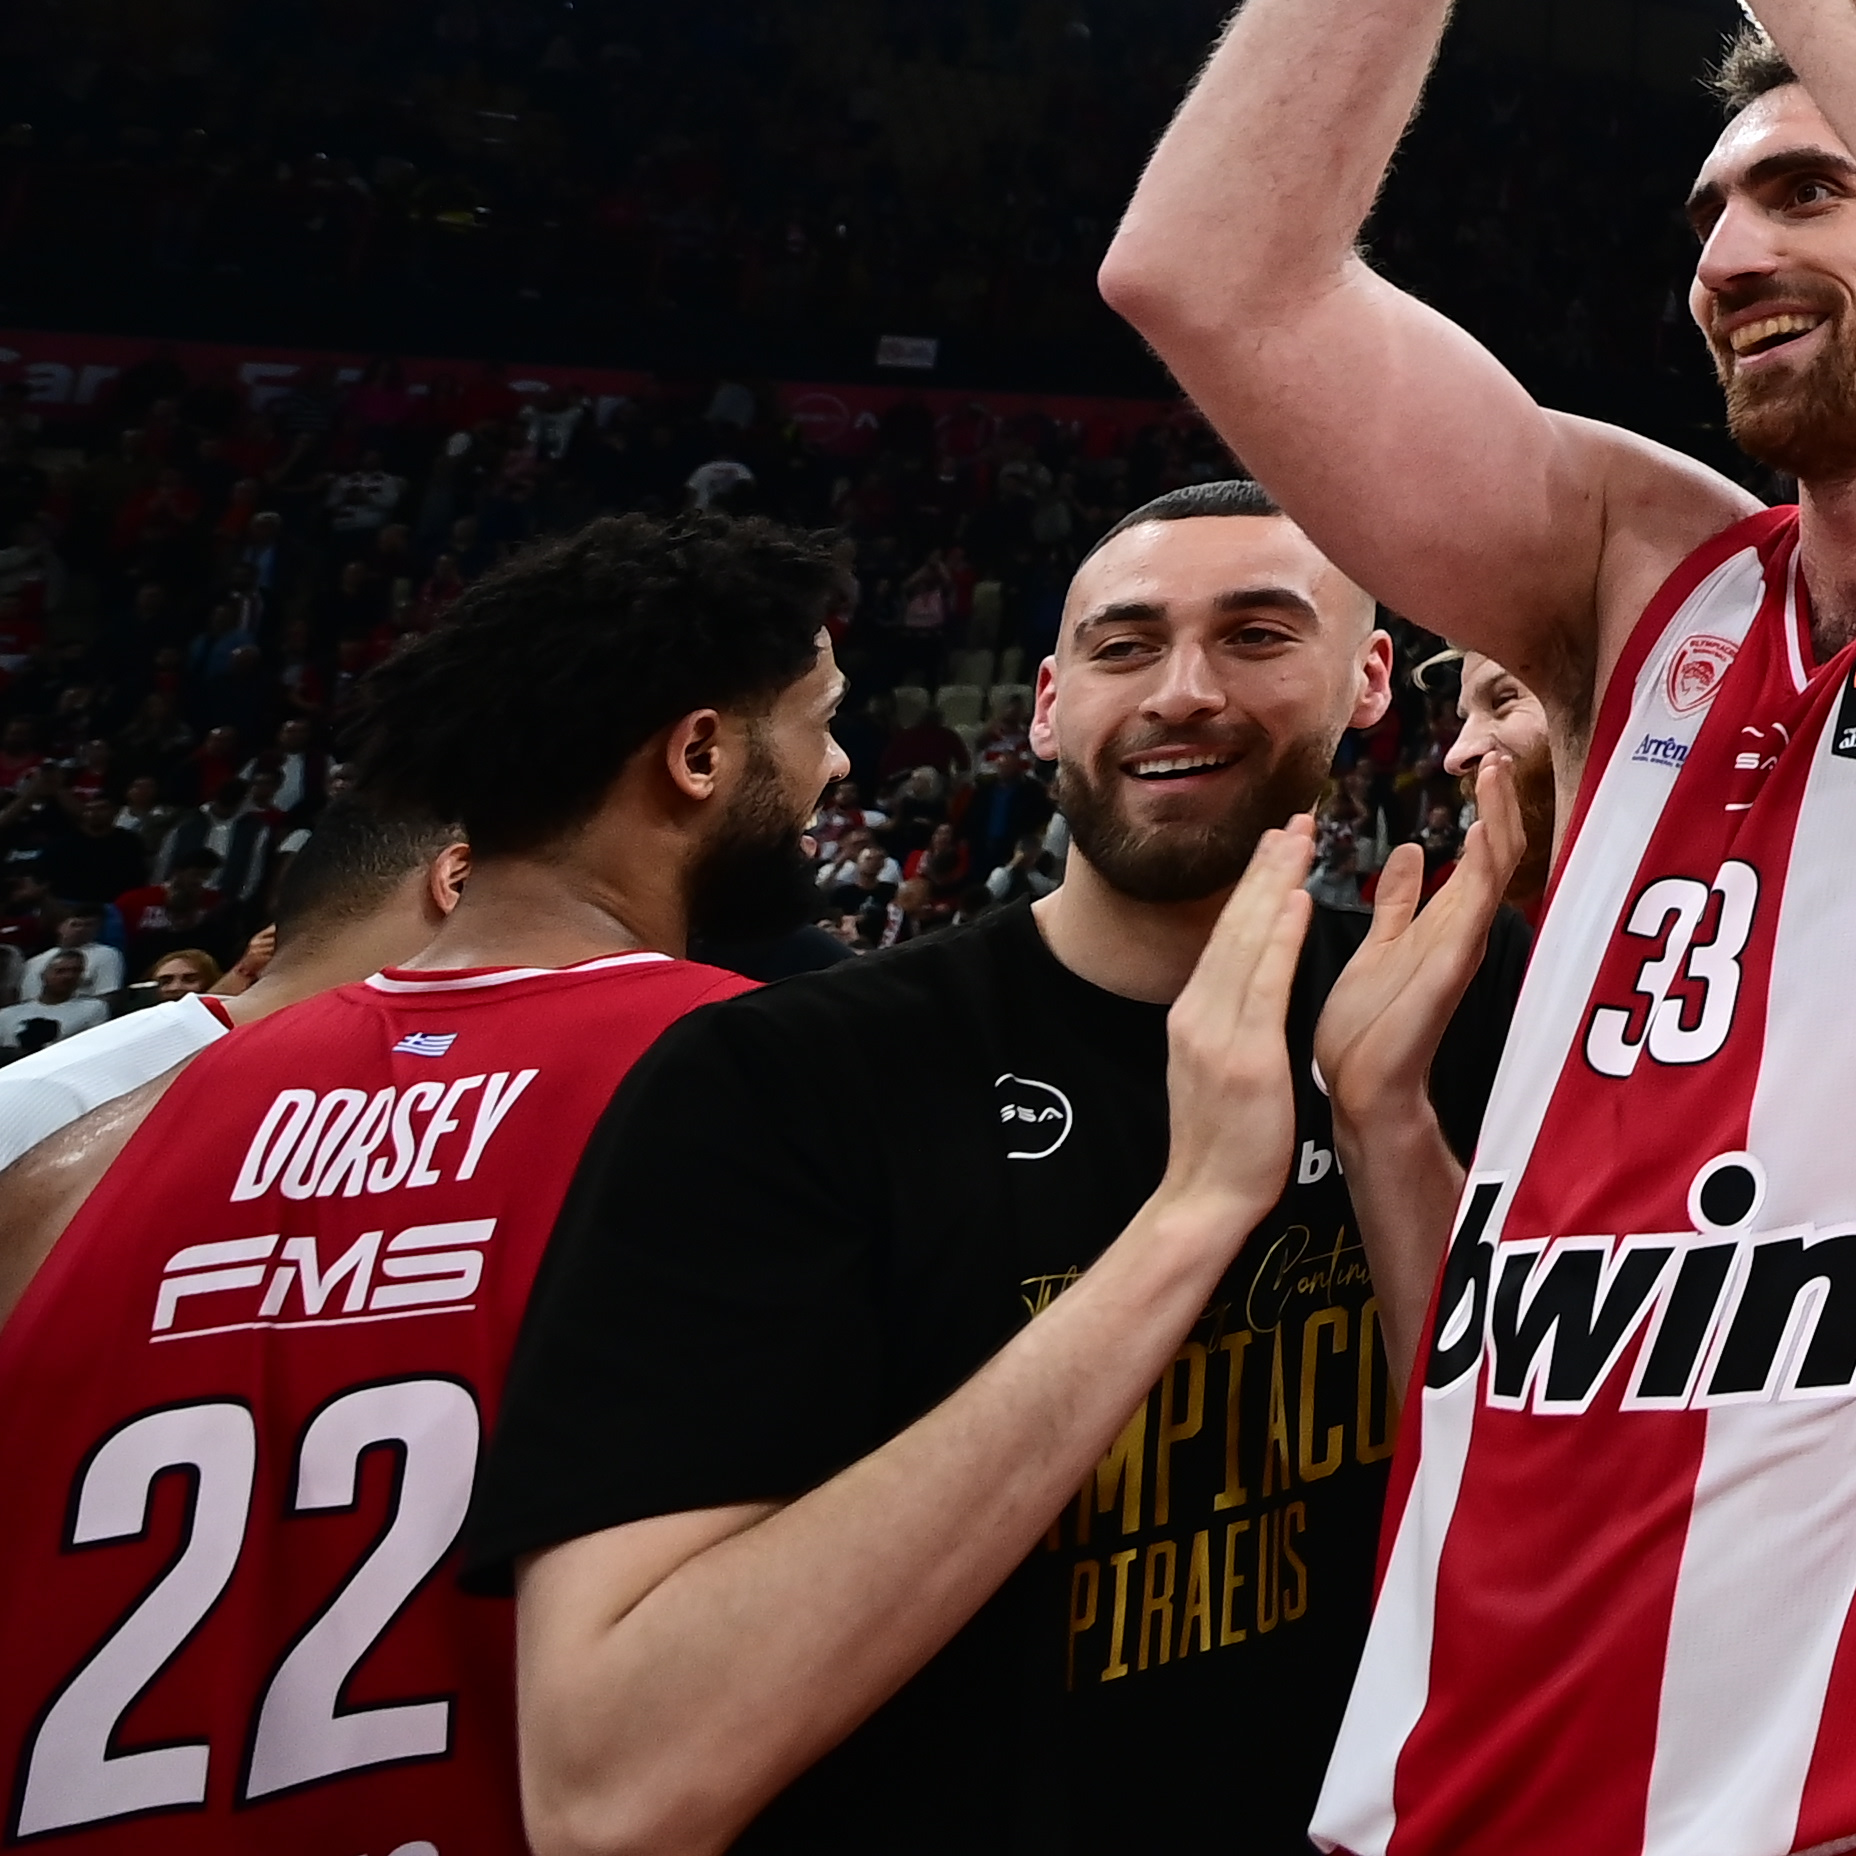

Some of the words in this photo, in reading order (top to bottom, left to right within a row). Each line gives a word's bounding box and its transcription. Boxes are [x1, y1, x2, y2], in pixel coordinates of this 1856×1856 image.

[1635, 733, 1688, 762] Arrên
[1734, 753, 1778, 770] SA
[1586, 860, 1759, 1077] 33
[230, 1068, 539, 1201] DORSEY
[151, 1218, 497, 1335] FMS
[14, 1374, 482, 1841] 22
[1066, 1500, 1307, 1691] PIRAEUS
